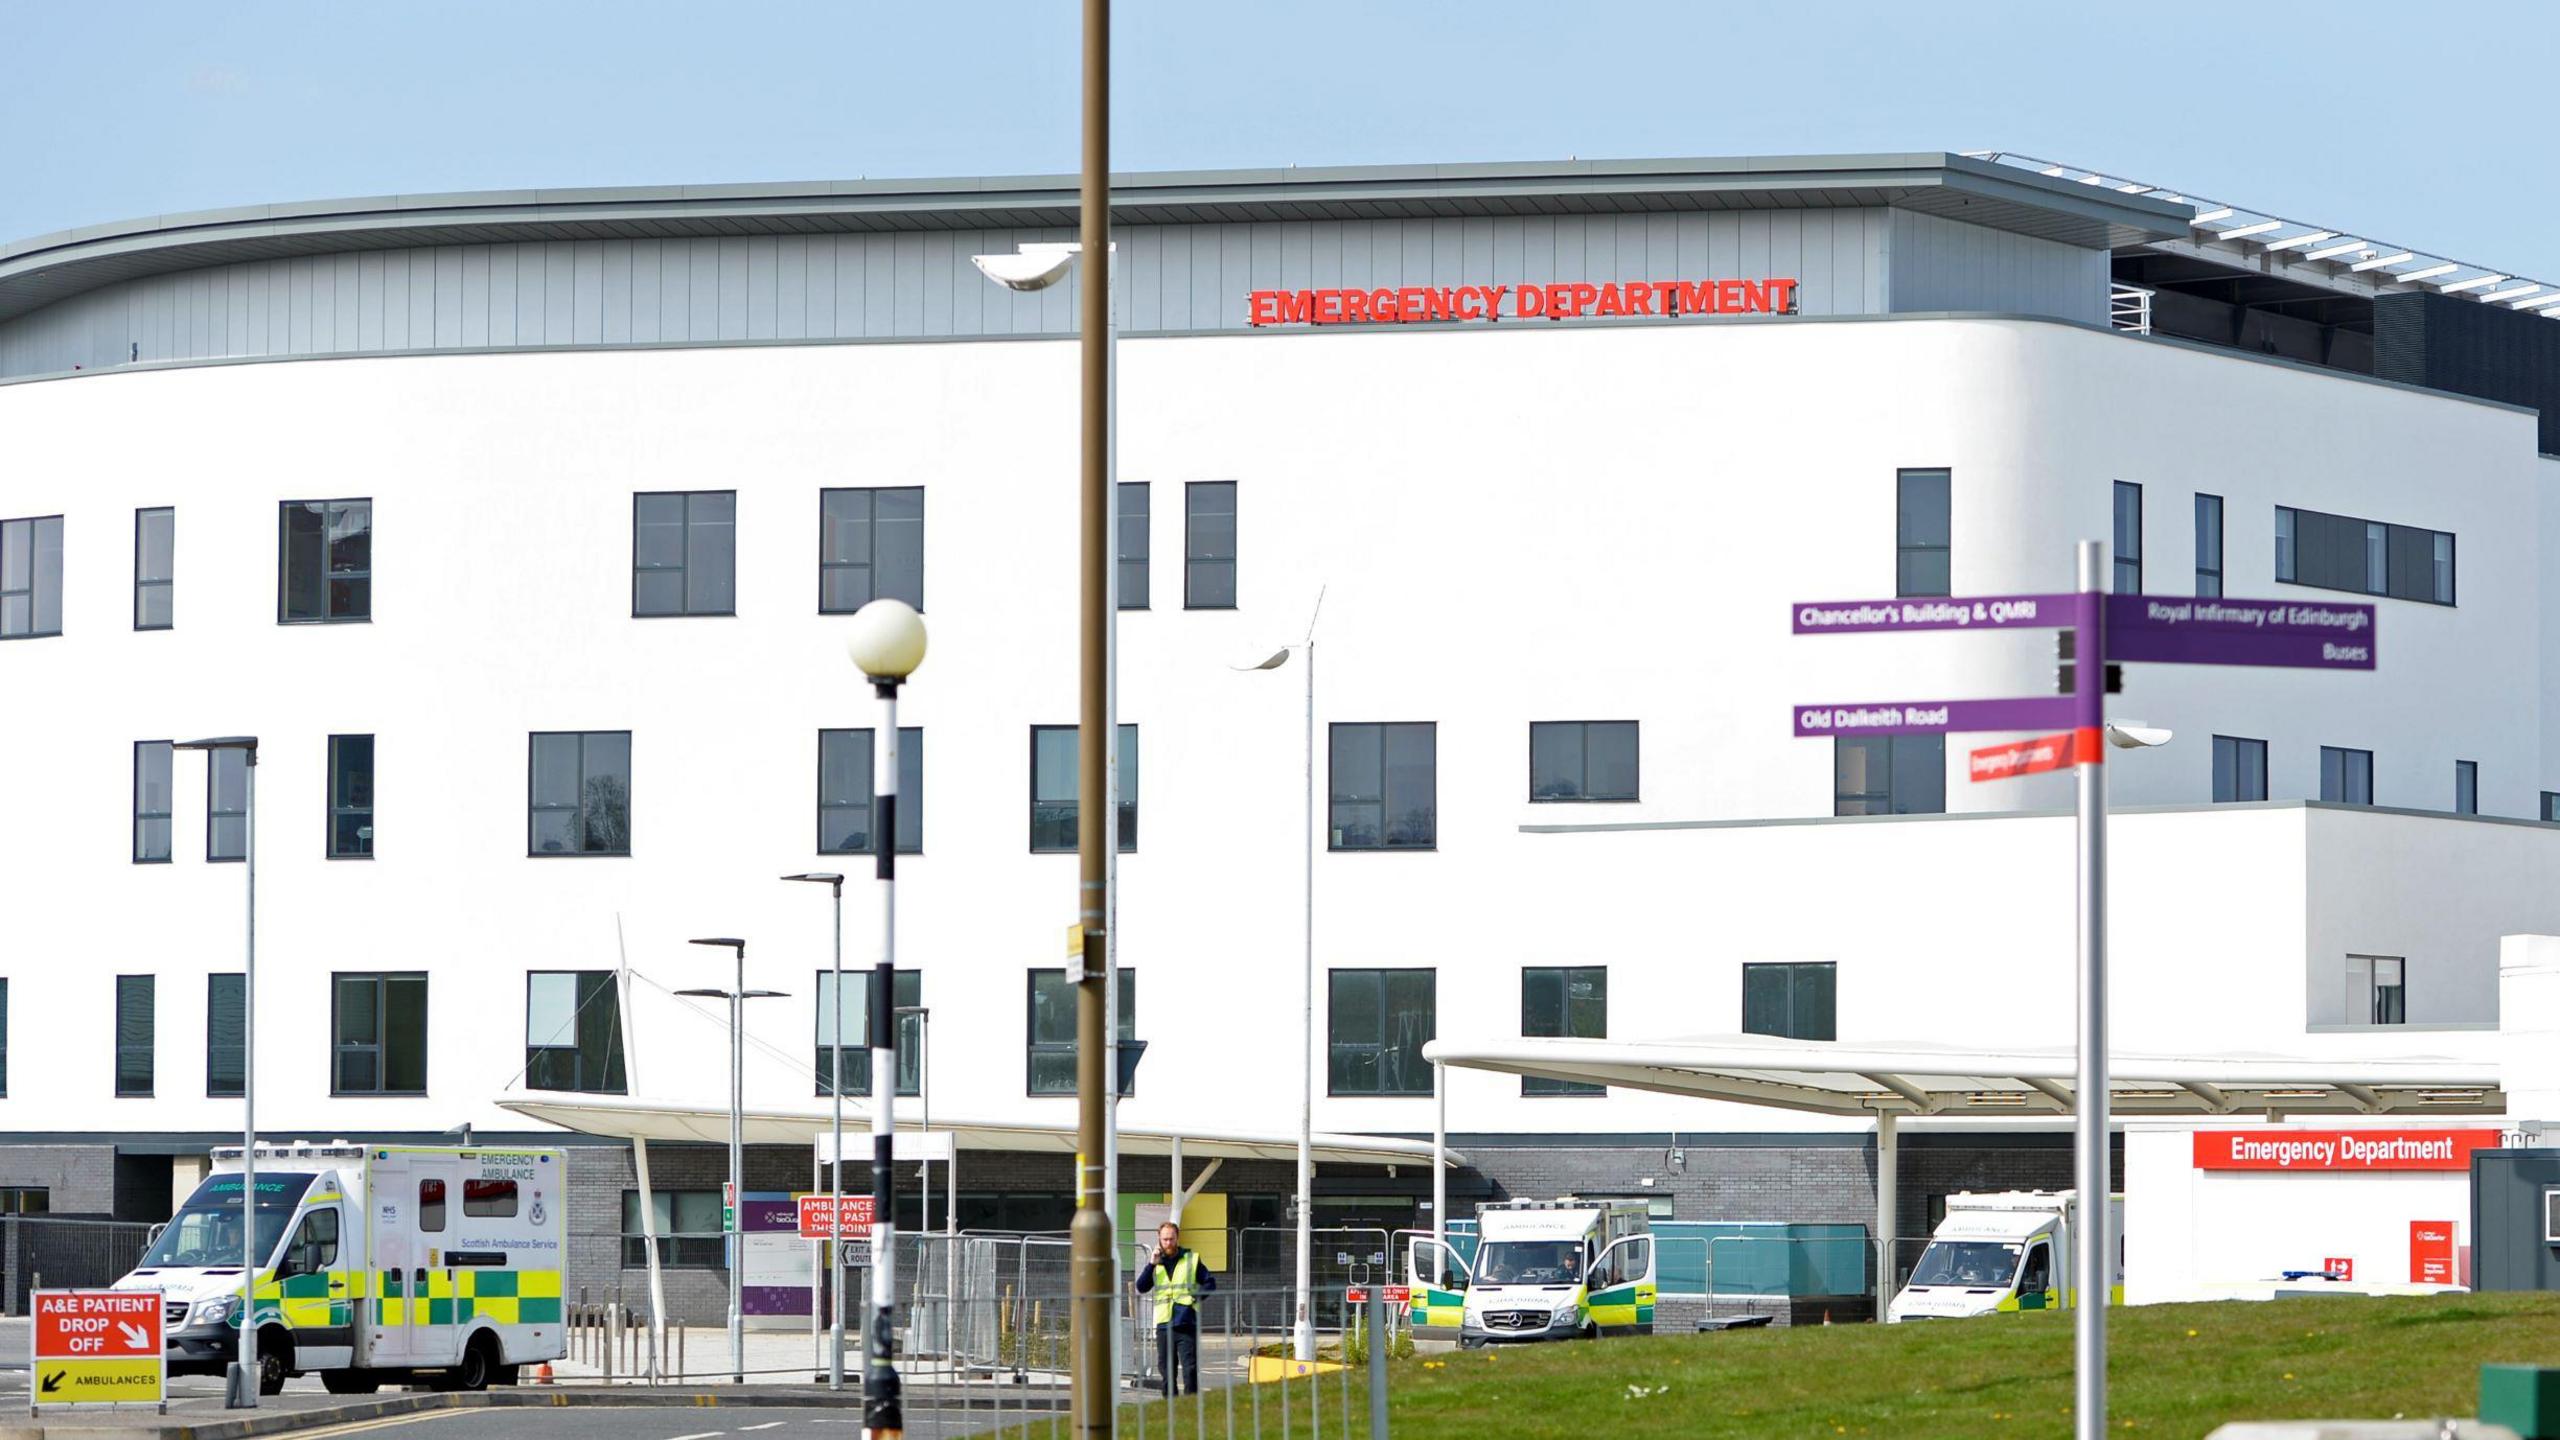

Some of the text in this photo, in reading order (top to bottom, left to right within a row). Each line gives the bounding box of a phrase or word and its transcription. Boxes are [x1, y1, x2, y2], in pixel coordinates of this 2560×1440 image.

[1251, 278, 1796, 324] EMERGENCY DEPARTMENT
[1800, 607, 1899, 626] Chancellor's
[1902, 603, 1970, 625] Building
[1973, 602, 1987, 620] &
[2148, 602, 2368, 631] Royal Infirmary of Edinburgh
[2323, 642, 2368, 661] Buses
[1801, 706, 1948, 728] Old Dalkeith Road
[2231, 1136, 2453, 1166] Emergency Department
[481, 1153, 534, 1165] EMERGENCY
[481, 1167, 534, 1180] AMBULANCE
[812, 1212, 873, 1222] ONL PAST
[461, 1238, 558, 1249] Scottish Ambulance Service
[850, 1246, 864, 1254] EXIT
[42, 1298, 155, 1313] A&E PATIENT
[59, 1318, 110, 1332] DROP
[69, 1338, 105, 1352] OFF
[75, 1375, 156, 1385] AMBULANCES
